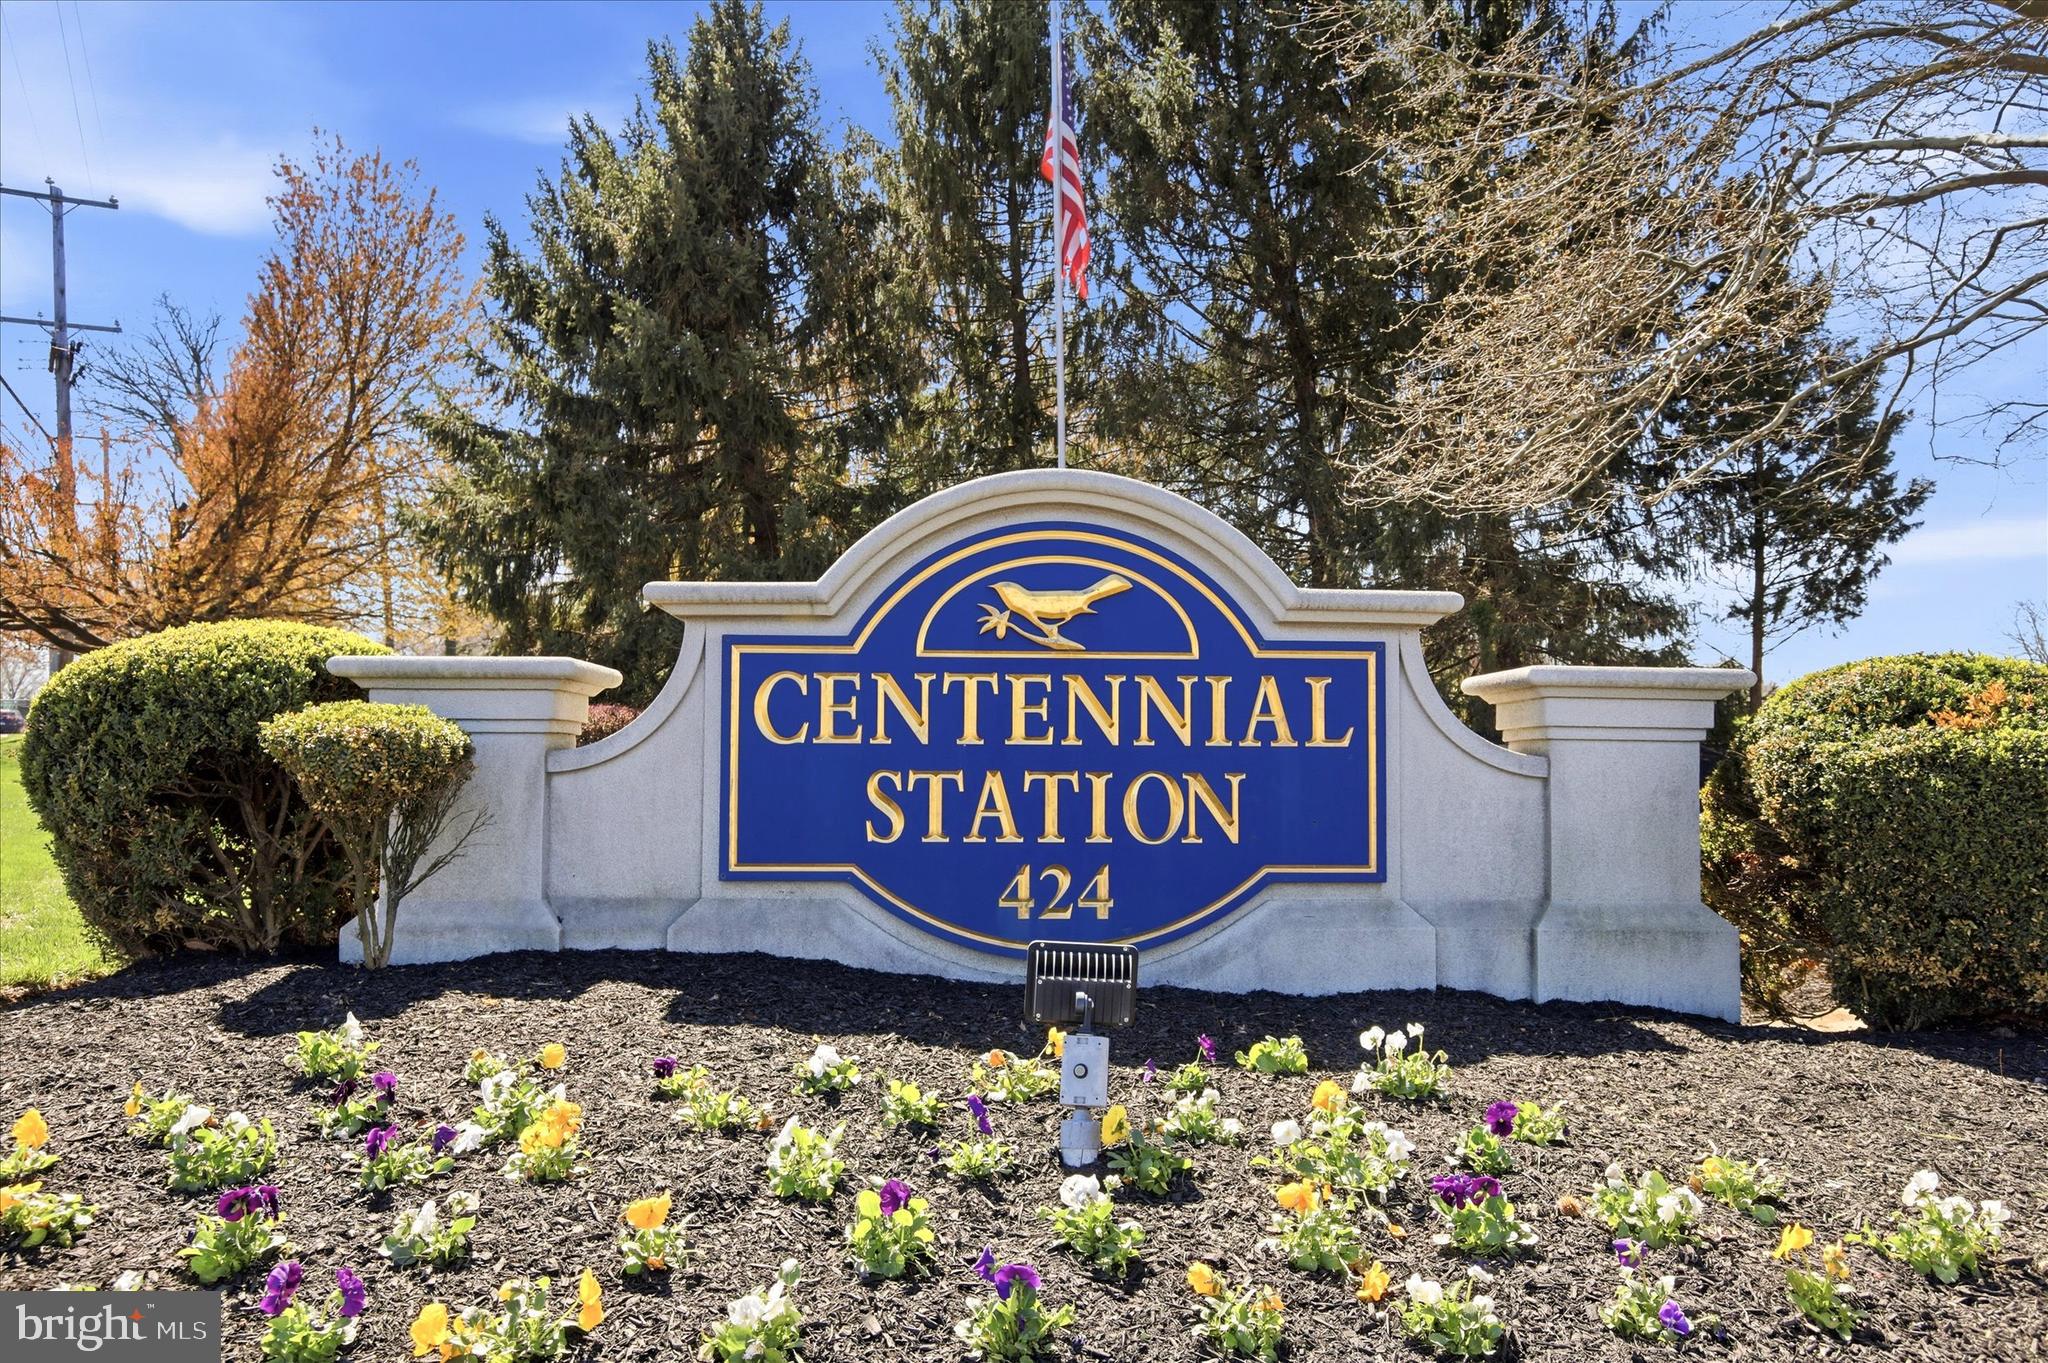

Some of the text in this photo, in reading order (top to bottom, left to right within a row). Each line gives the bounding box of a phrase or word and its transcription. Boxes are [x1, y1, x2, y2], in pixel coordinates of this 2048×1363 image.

[753, 670, 1355, 748] CENTENNIAL
[866, 769, 1246, 845] STATION
[999, 864, 1113, 920] 424
